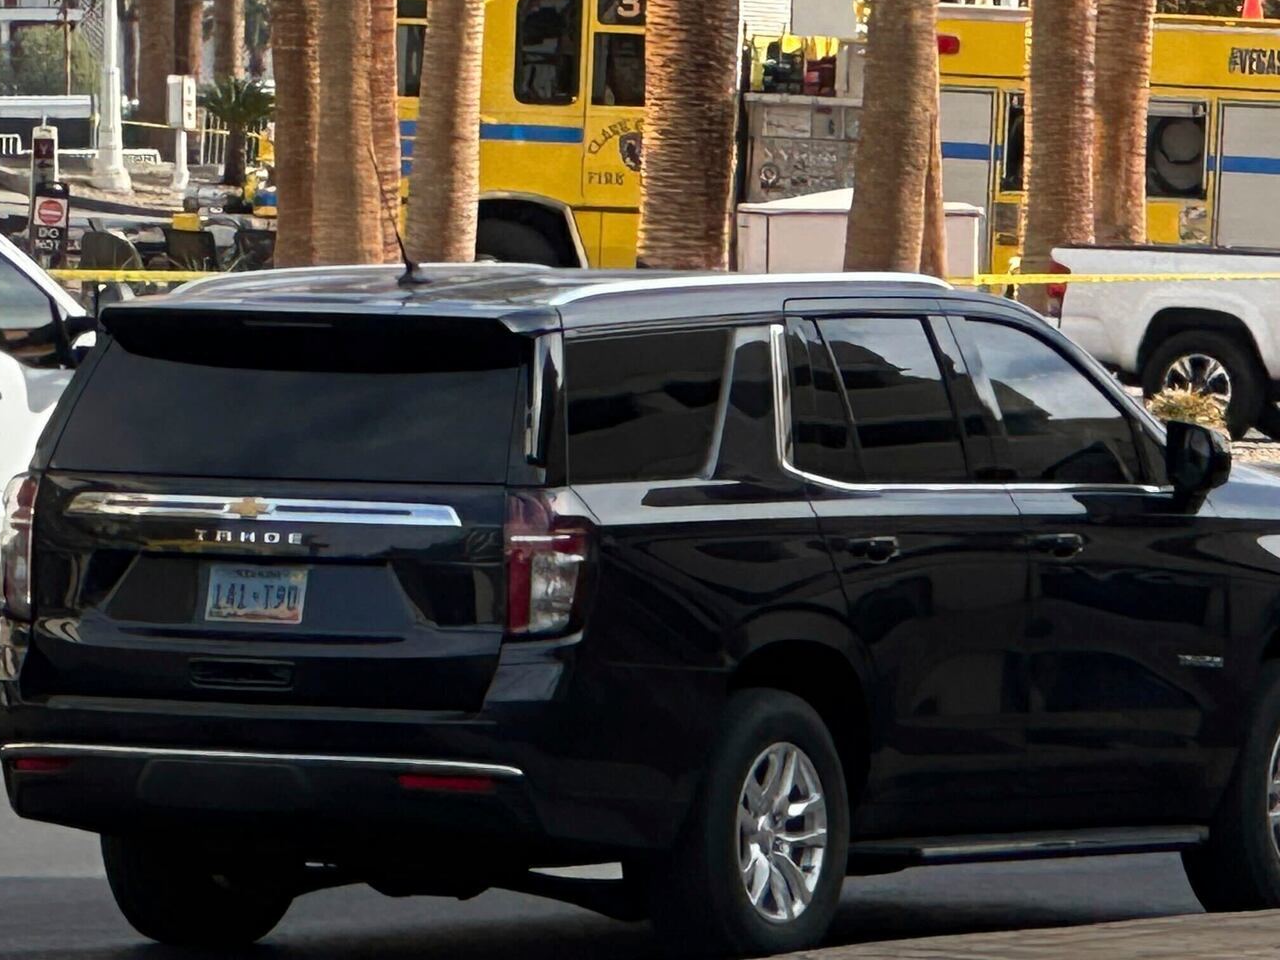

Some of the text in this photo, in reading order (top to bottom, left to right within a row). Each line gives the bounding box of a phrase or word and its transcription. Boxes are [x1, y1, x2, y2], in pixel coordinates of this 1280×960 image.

[588, 118, 631, 154] CLARK
[587, 171, 625, 186] FIRE
[38, 227, 60, 239] DO
[194, 529, 303, 544] TAHOE
